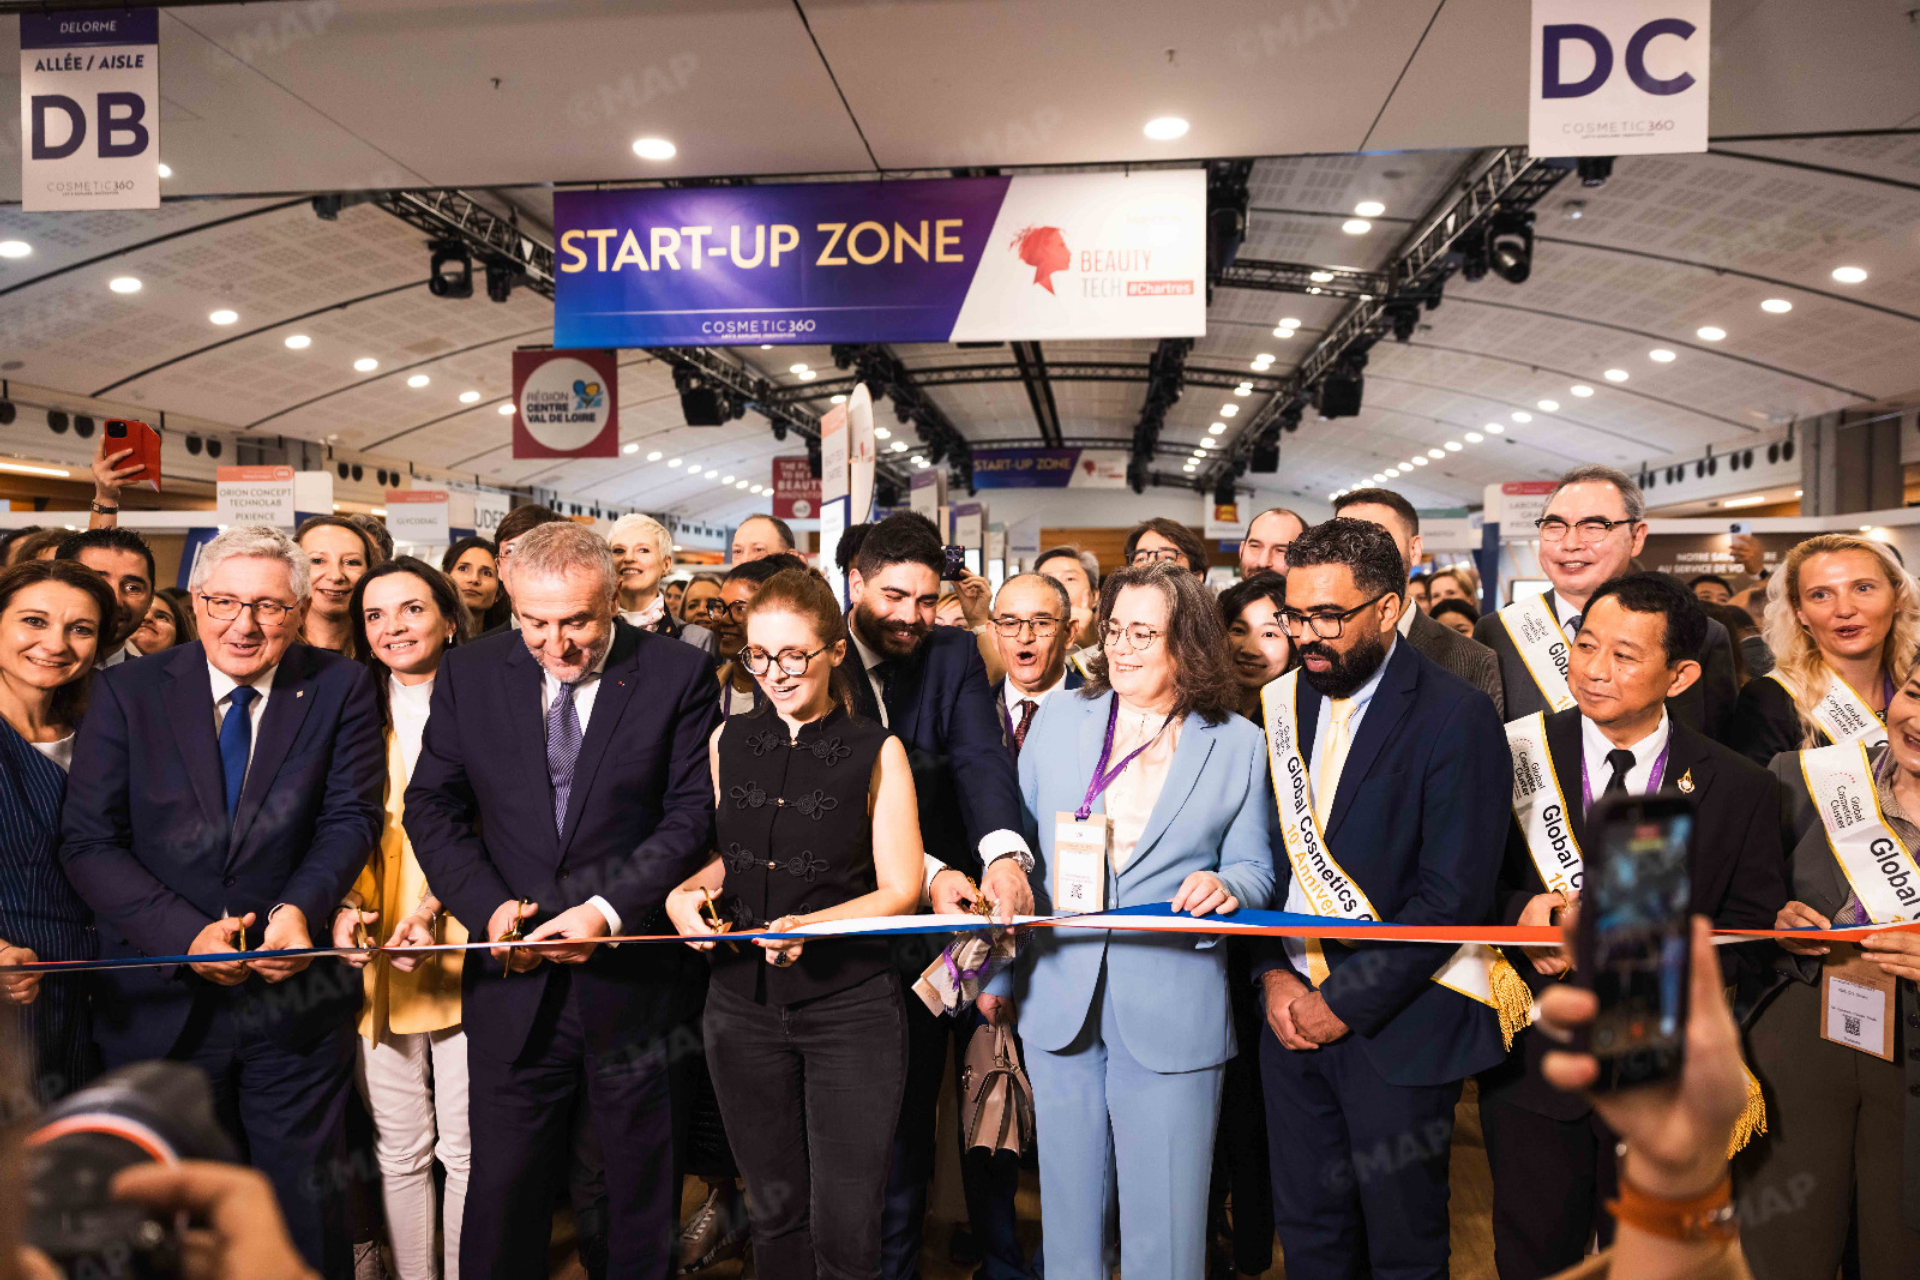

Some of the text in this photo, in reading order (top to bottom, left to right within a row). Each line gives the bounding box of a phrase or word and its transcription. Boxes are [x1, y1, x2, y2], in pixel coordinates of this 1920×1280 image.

[59, 21, 117, 34] DELORME
[35, 53, 82, 72] ALLÉE
[99, 54, 144, 70] AISLE
[1542, 18, 1697, 99] DC
[31, 92, 149, 160] DB
[1562, 119, 1675, 134] COSMETIC360
[47, 180, 134, 192] COSMETIC360
[560, 219, 964, 273] START-UP ZONE
[1080, 249, 1151, 273] BEAUTY
[1082, 277, 1122, 298] TECH
[702, 319, 816, 334] COSMETIC360
[526, 390, 569, 402] RÉGION
[526, 403, 569, 413] CENTRE
[527, 412, 596, 423] VAL DE LOIRE
[973, 458, 1071, 472] START-UP ZONE
[219, 487, 292, 497] ORION CONCEPT
[230, 499, 282, 507] TECHNOLAB
[235, 513, 275, 521] PIXIENCE
[1830, 799, 1846, 829] Cluster
[1287, 756, 1357, 913] Global Cosmetics
[1542, 804, 1580, 869] Global
[1870, 838, 1920, 907] Global
[1294, 852, 1339, 918] Anniver
